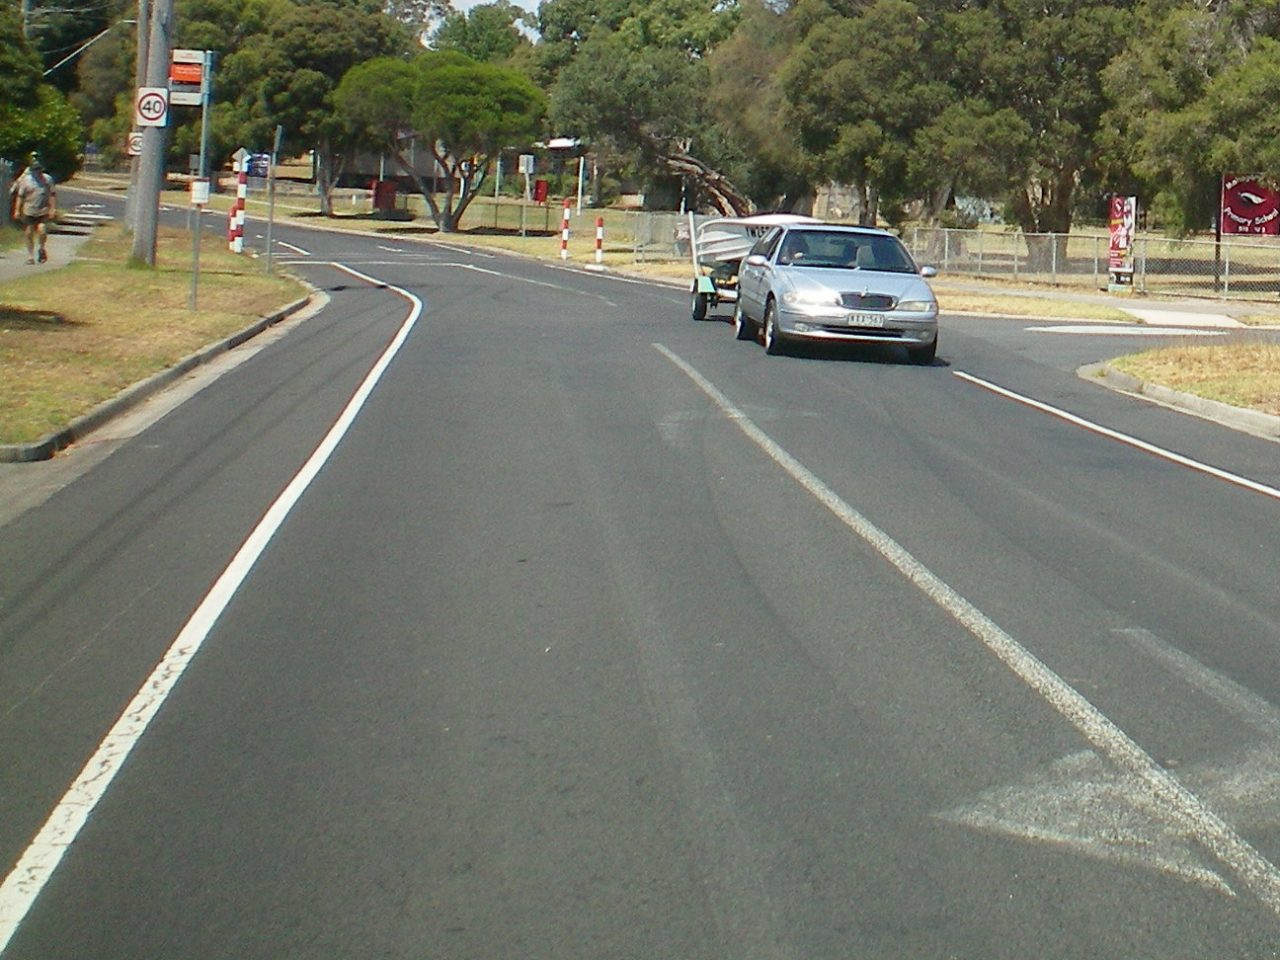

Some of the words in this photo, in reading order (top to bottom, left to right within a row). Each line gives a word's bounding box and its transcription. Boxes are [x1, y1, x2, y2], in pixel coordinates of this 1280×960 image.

[142, 100, 161, 114] 40
[1224, 206, 1253, 227] Primary
[1254, 207, 1280, 225] School
